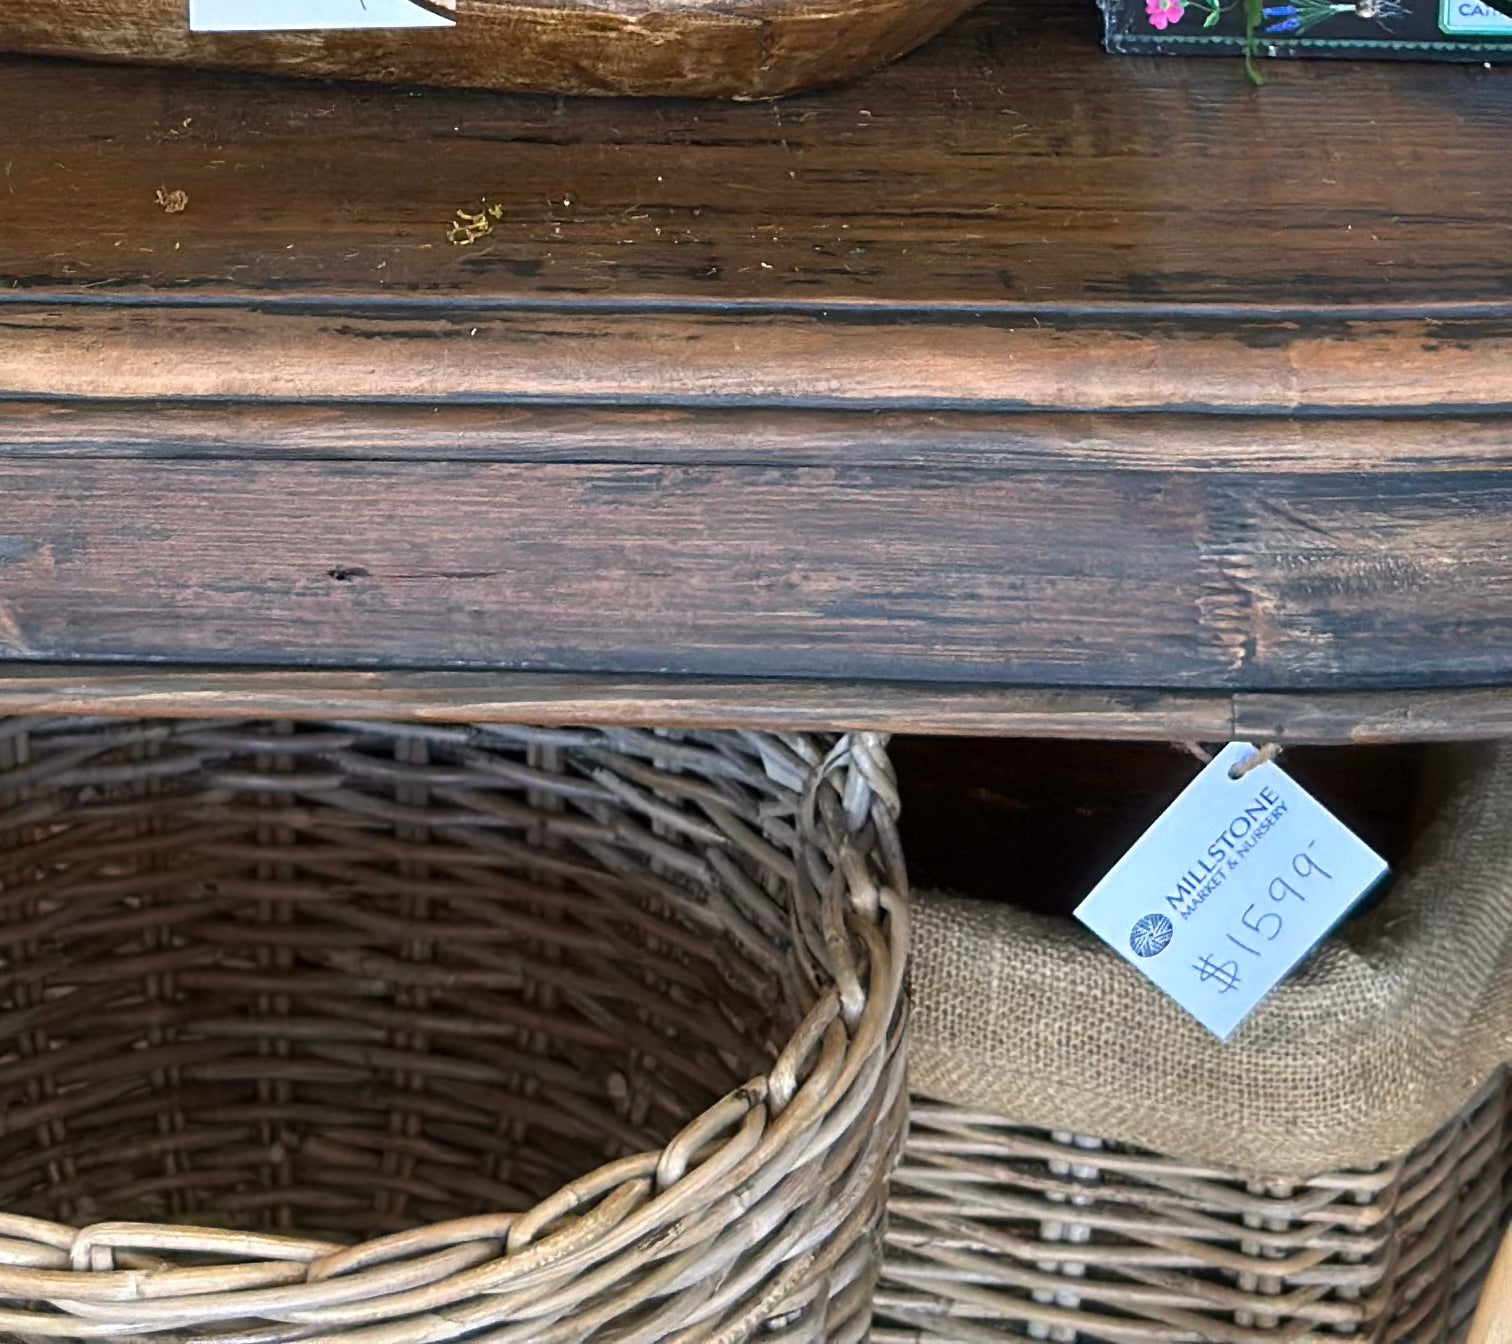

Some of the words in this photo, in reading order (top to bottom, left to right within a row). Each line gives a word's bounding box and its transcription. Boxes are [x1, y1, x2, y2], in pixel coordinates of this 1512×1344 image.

[1165, 785, 1280, 911] MILLSTONE
[1179, 869, 1228, 921] MARKET
[1227, 857, 1240, 870] &
[1237, 800, 1289, 861] NURSERY
